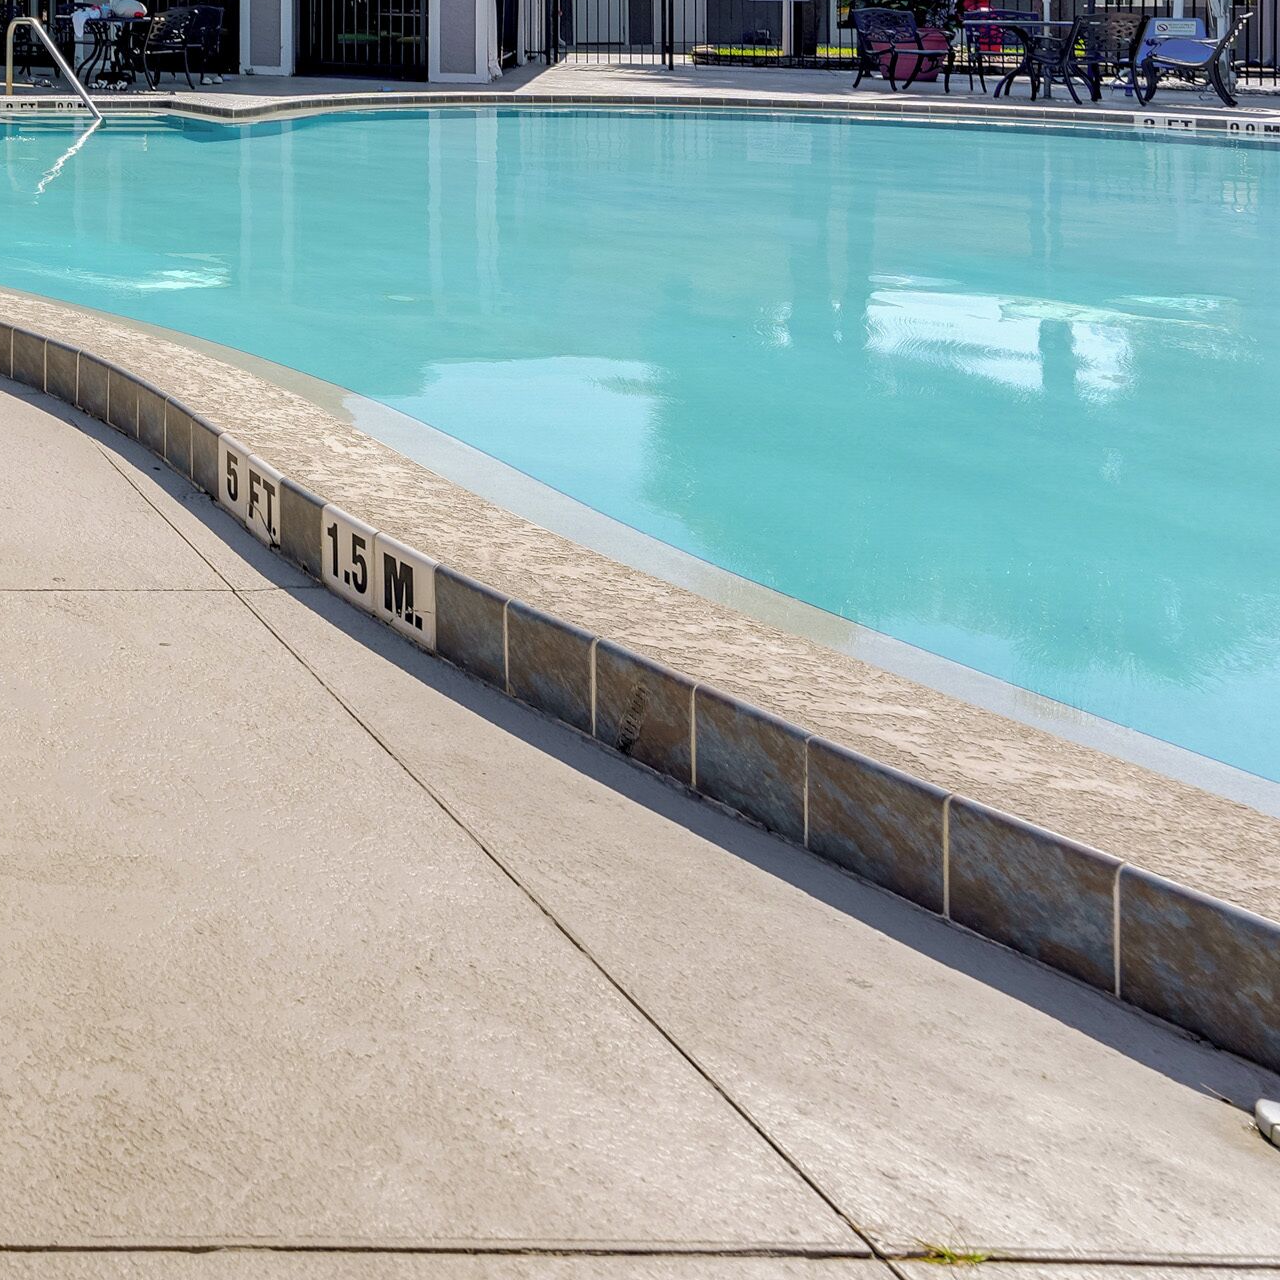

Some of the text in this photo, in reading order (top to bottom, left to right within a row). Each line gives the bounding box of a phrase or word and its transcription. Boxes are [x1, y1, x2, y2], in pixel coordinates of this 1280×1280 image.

[226, 450, 277, 537] 5 FT.
[327, 522, 423, 632] 1.5 M.
